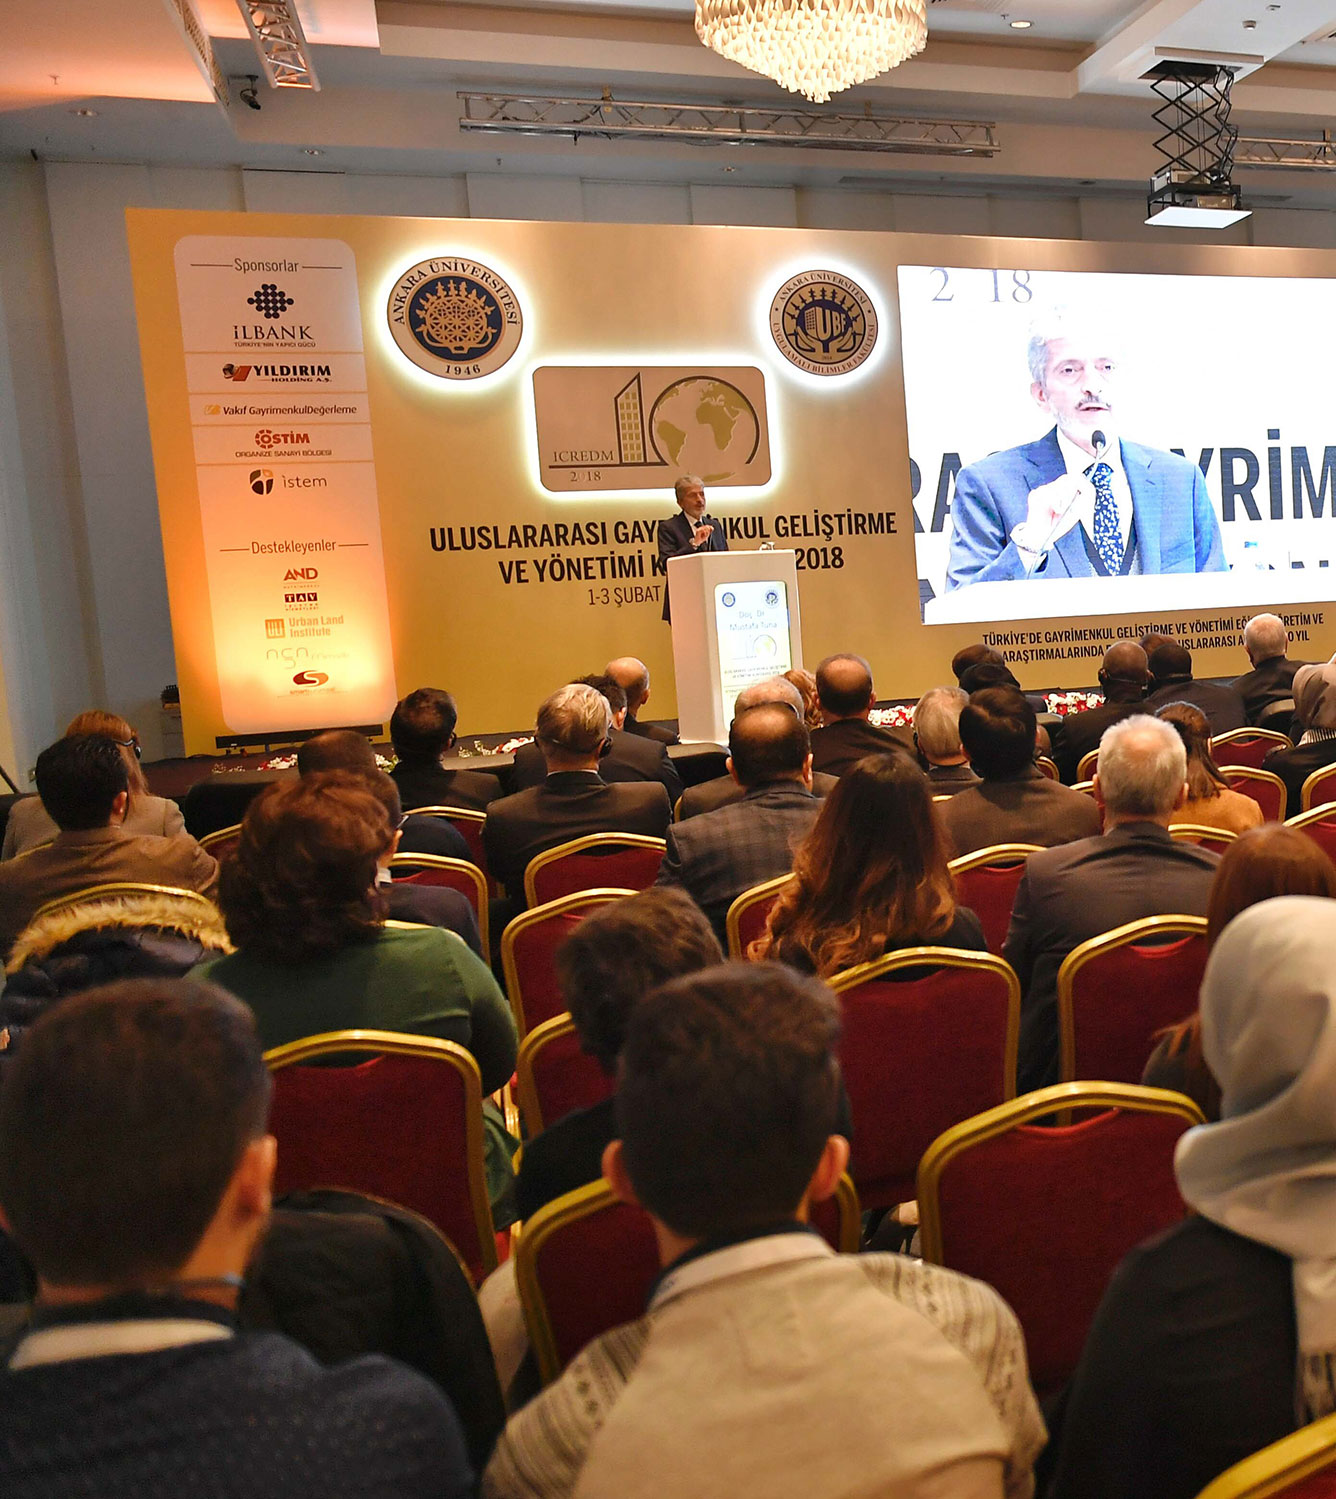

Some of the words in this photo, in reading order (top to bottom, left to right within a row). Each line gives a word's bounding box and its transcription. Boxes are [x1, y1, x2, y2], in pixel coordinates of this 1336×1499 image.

[234, 257, 299, 275] Sponsorlar
[393, 269, 428, 325] ANKARA
[429, 259, 520, 325] ÜNİVERSİTESİ
[253, 365, 331, 376] YILDIRIM
[445, 364, 481, 375] 1946
[223, 405, 247, 415] Vakıf
[554, 450, 614, 462] ICREDM
[281, 474, 327, 488] istem
[430, 521, 607, 551] ULUSLARARASI
[774, 508, 897, 541] GELİŞTİRME
[251, 540, 337, 555] Destekleyenler
[498, 560, 529, 584] VE
[533, 550, 644, 583] YÖNETİMİ
[795, 546, 844, 570] 2018
[283, 567, 318, 581] AND
[284, 592, 318, 603] TAV
[588, 588, 610, 605] 1-3
[614, 585, 661, 608] ŞUBAT
[288, 617, 318, 627] Urban
[320, 615, 344, 625] Land
[983, 631, 1042, 646] TÜRKİYE'DE
[1045, 628, 1115, 643] GAYRİMENKUL
[1175, 623, 1187, 635] VE
[1189, 617, 1233, 633] YÖNETİMİ
[1312, 612, 1324, 624] VE
[1003, 644, 1104, 664] ARAŞTIRMALARINDA
[1178, 635, 1236, 650] USLARARASI
[1295, 630, 1310, 641] YIL
